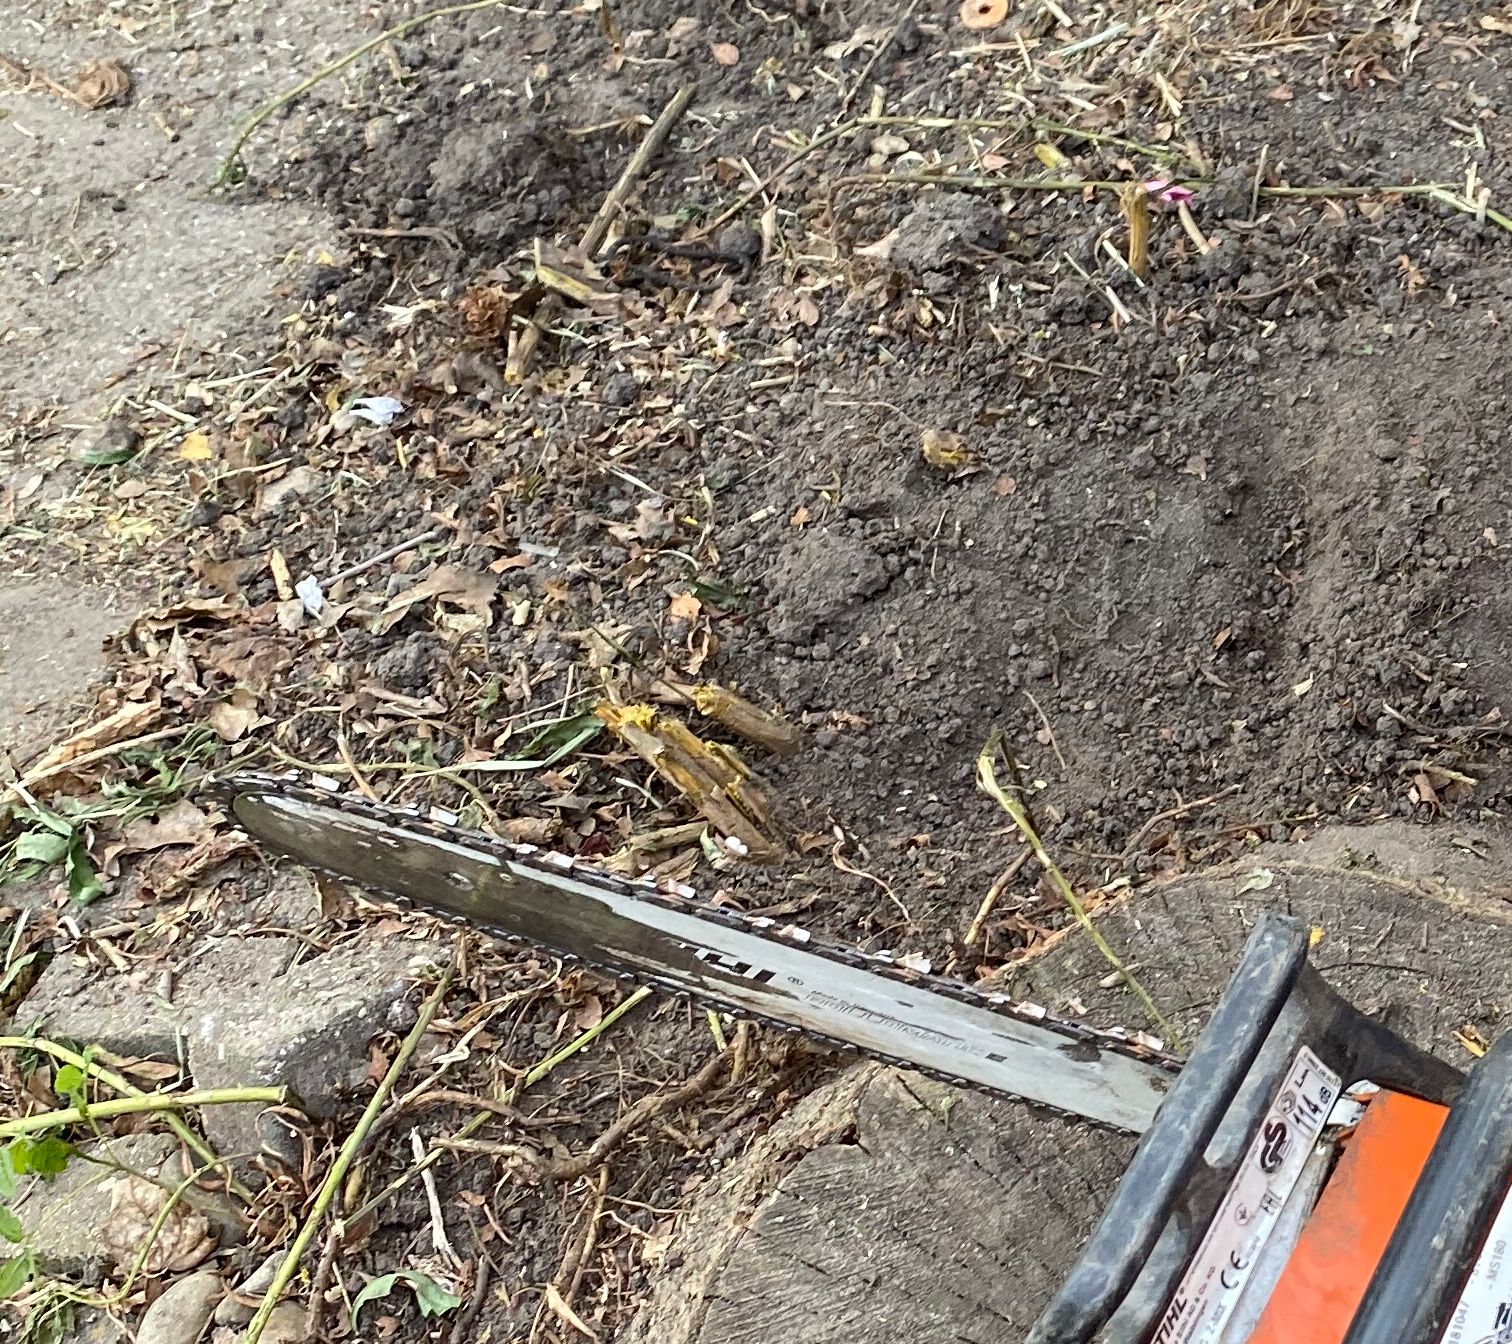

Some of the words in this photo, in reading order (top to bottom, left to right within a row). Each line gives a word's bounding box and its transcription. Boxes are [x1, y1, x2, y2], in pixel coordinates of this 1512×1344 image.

[1293, 1094, 1323, 1135] 114
[1319, 1085, 1332, 1104] dB
[1220, 1249, 1250, 1289] CE
